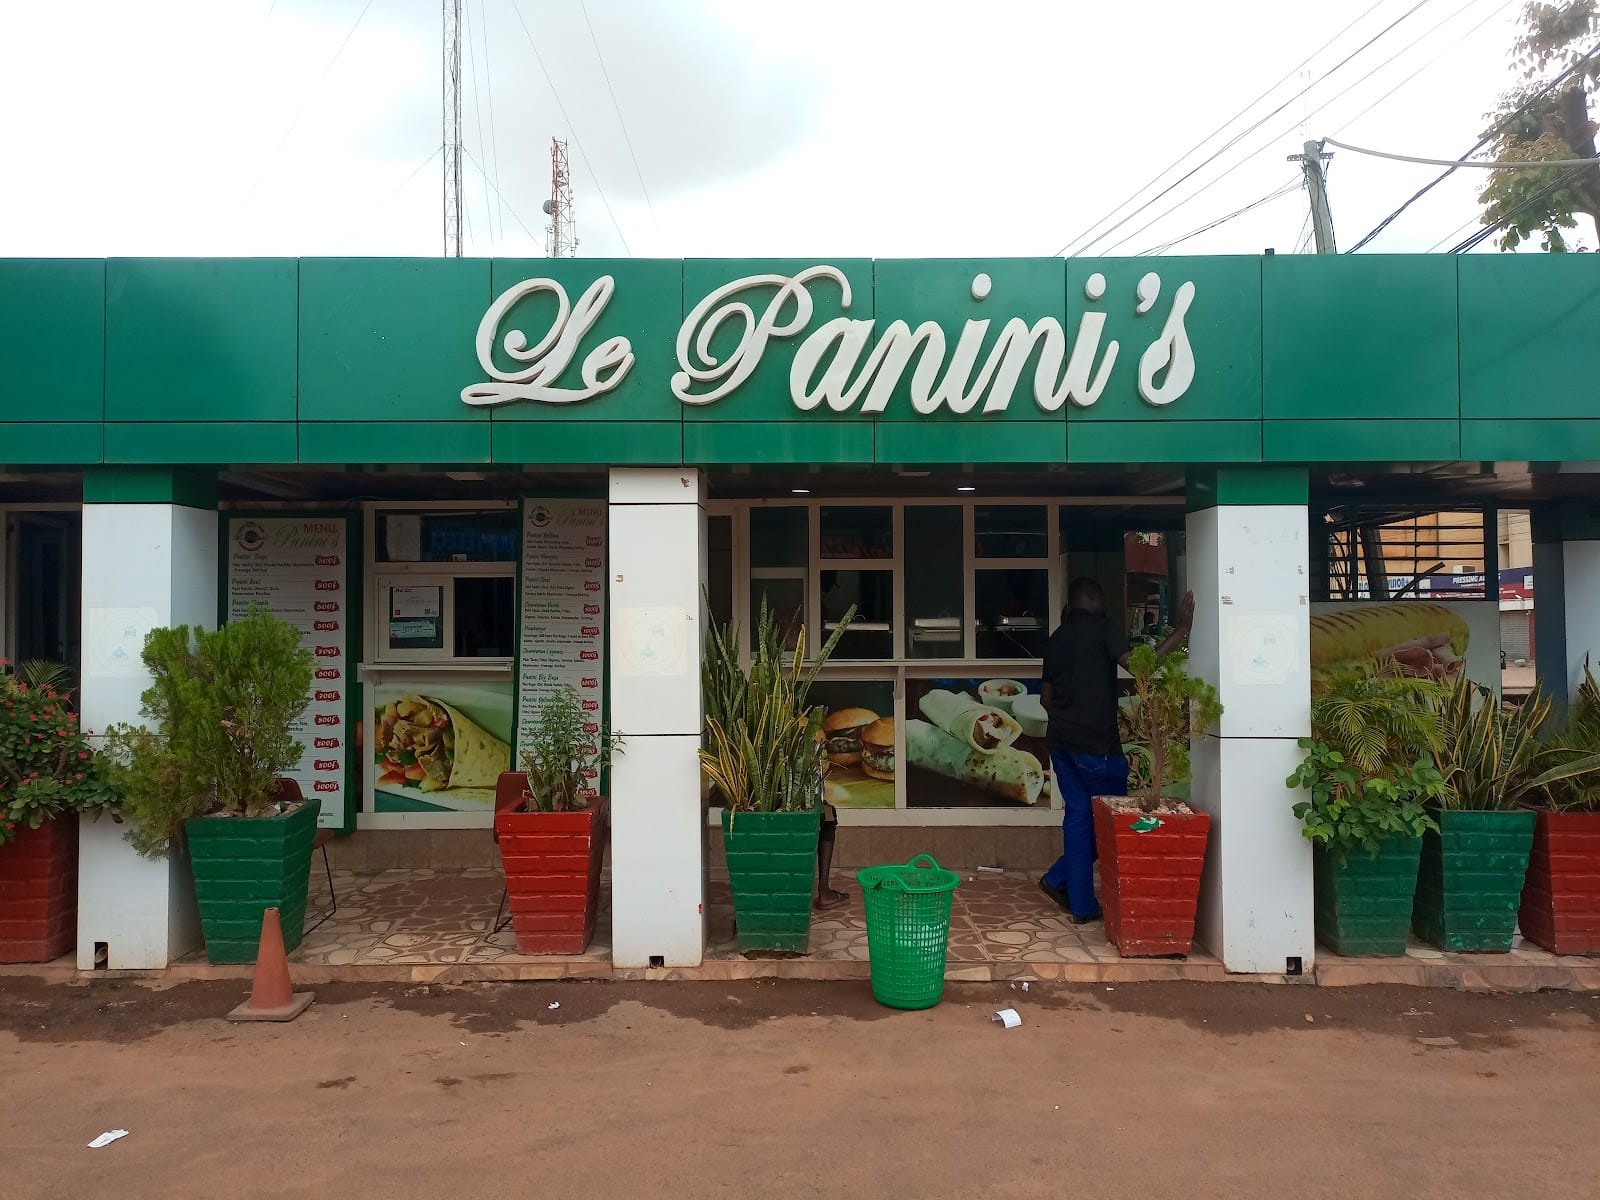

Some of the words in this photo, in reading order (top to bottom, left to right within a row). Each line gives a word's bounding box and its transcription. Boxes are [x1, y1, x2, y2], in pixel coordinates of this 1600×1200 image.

[460, 275, 635, 405] Le
[671, 266, 1196, 414] Panini's
[303, 522, 336, 534] MENU
[1452, 575, 1478, 585] PRESSING
